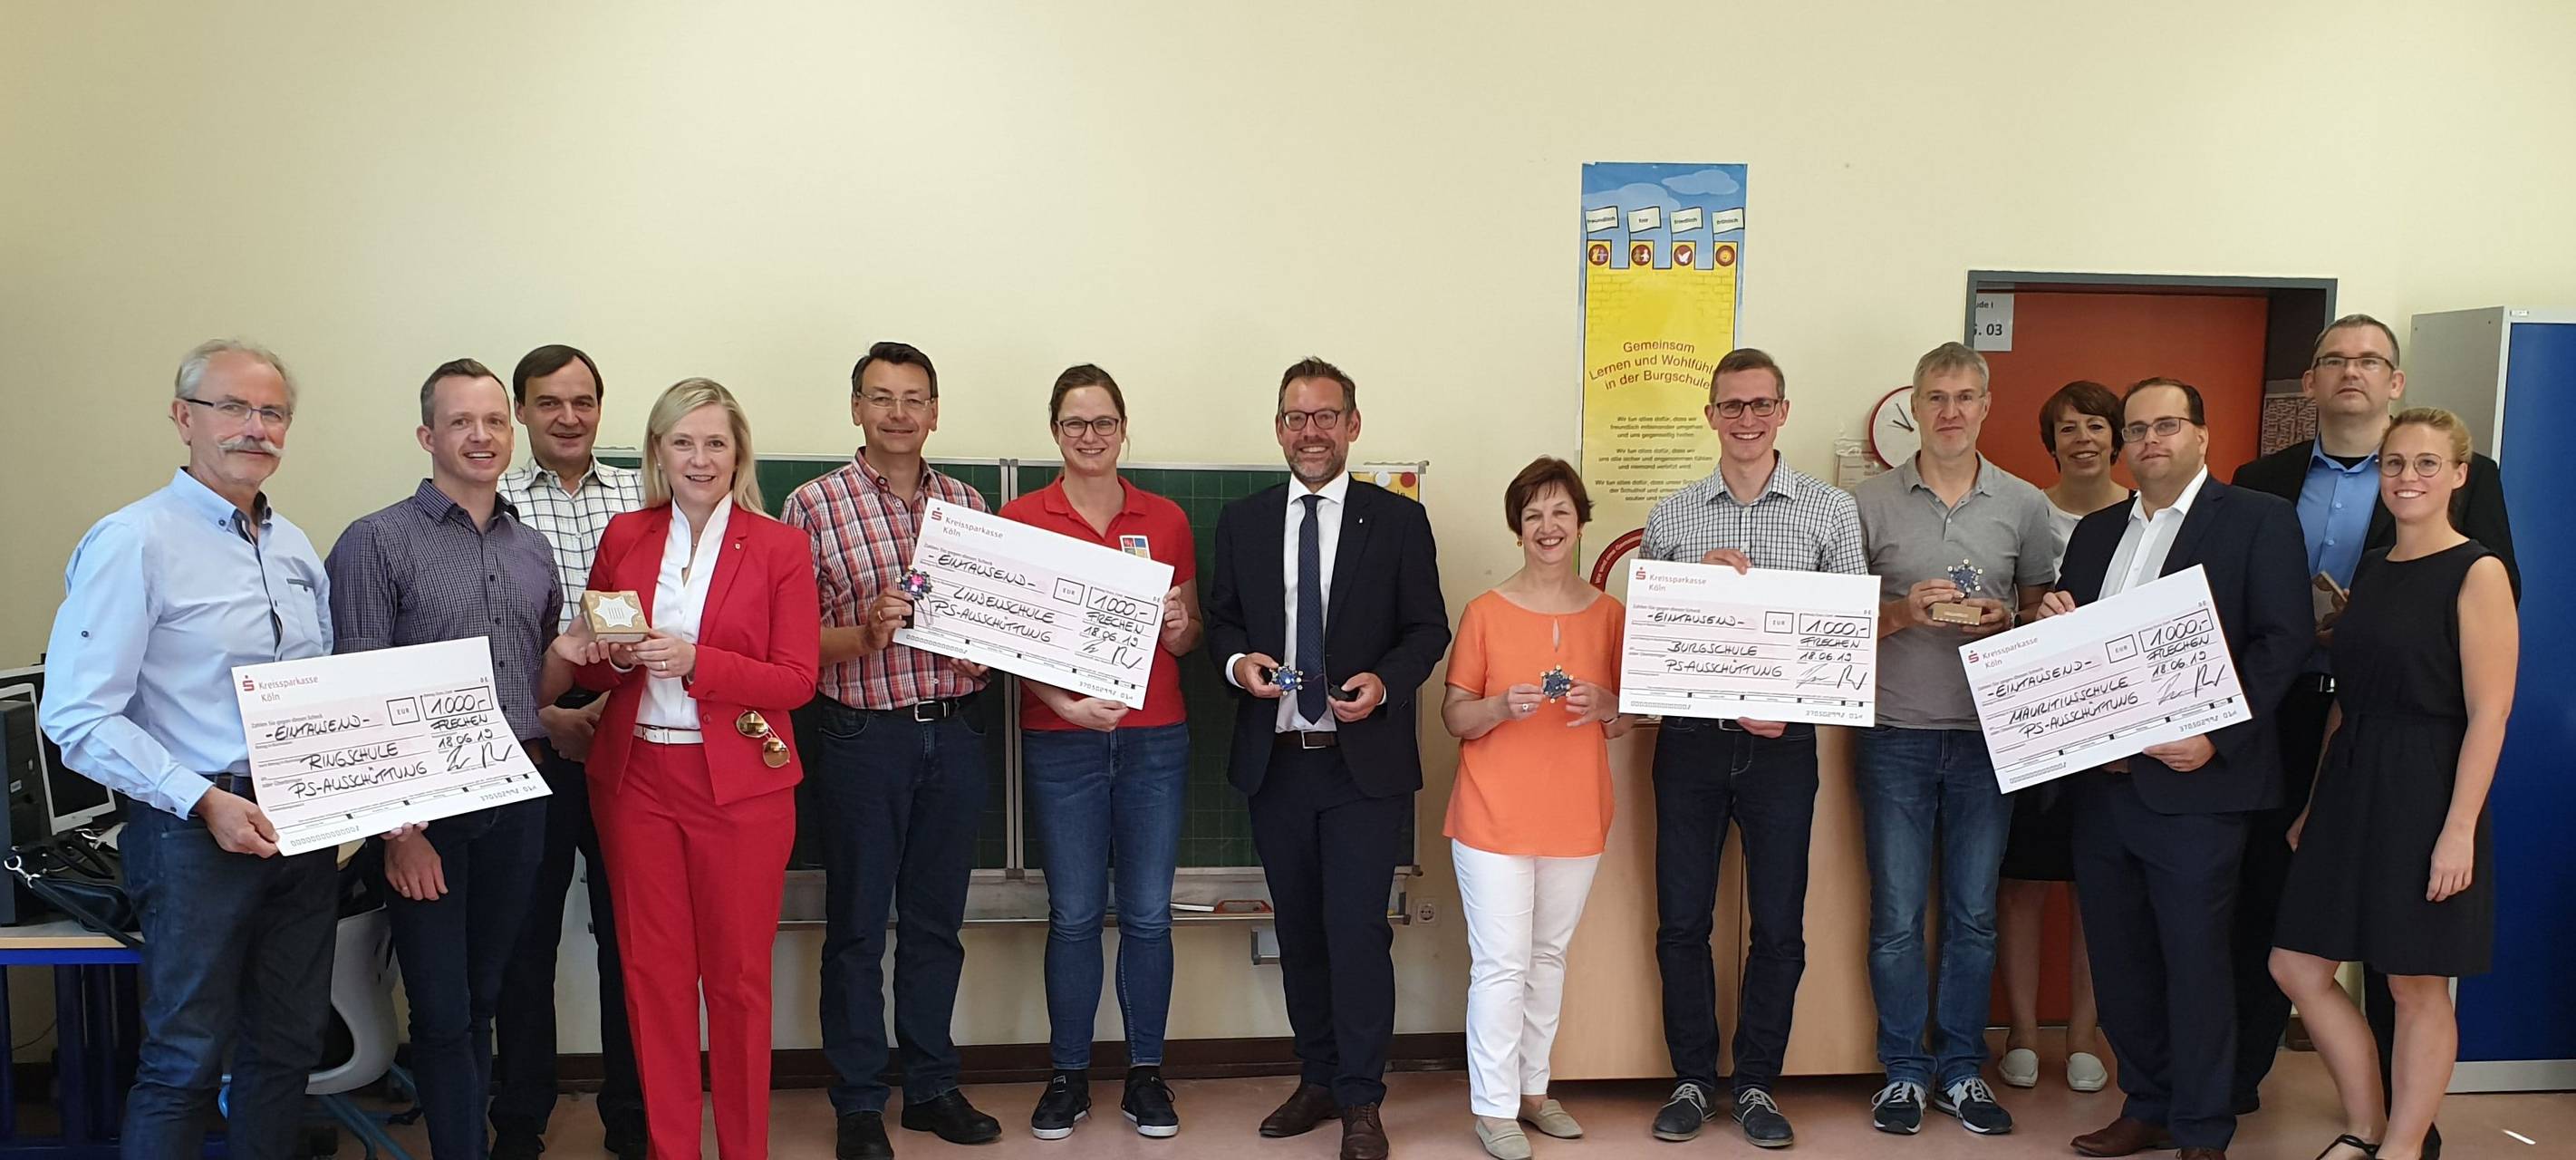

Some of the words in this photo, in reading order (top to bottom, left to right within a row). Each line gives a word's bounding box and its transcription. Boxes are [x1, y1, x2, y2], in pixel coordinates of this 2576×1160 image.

[1986, 324, 2002, 335] 03
[1623, 339, 1695, 353] Gemeinsam
[1588, 360, 1632, 381] Lernen
[1635, 354, 1657, 367] und
[1605, 380, 1616, 390] in
[1619, 373, 1640, 385] der
[1644, 370, 1711, 390] Burgschule
[942, 527, 960, 537] Köln
[945, 517, 1004, 538] Kreissparkasse
[1648, 584, 1666, 592] Köln
[1649, 574, 1707, 585] Kreissparkasse
[1062, 587, 1076, 595] EUR
[953, 586, 1055, 624] LINDENSCHULE
[931, 599, 1051, 643] PS-AUSSCHÜTTUNG
[1085, 612, 1144, 634] FRECHEN
[1667, 641, 1758, 656] BURGSCHULE
[1800, 636, 1860, 648] FRECHEN
[1983, 637, 2038, 659] Kreissparkasse
[2147, 633, 2209, 661] FRECHEN
[1664, 659, 1782, 677] PS-AUSSCHÜTTUNG
[1985, 659, 2002, 669] Köln
[258, 675, 318, 690] Kreissparkasse
[261, 692, 280, 702] Köln
[2009, 676, 2129, 724] MAURITIUSSCHULE
[430, 714, 488, 730] FRECHEN
[2019, 691, 2138, 739] PS-AUSSCHÜTTUNG
[300, 742, 399, 770] RINGSCHULE
[288, 761, 428, 799] PS-AUSSCHÜTTUNG
